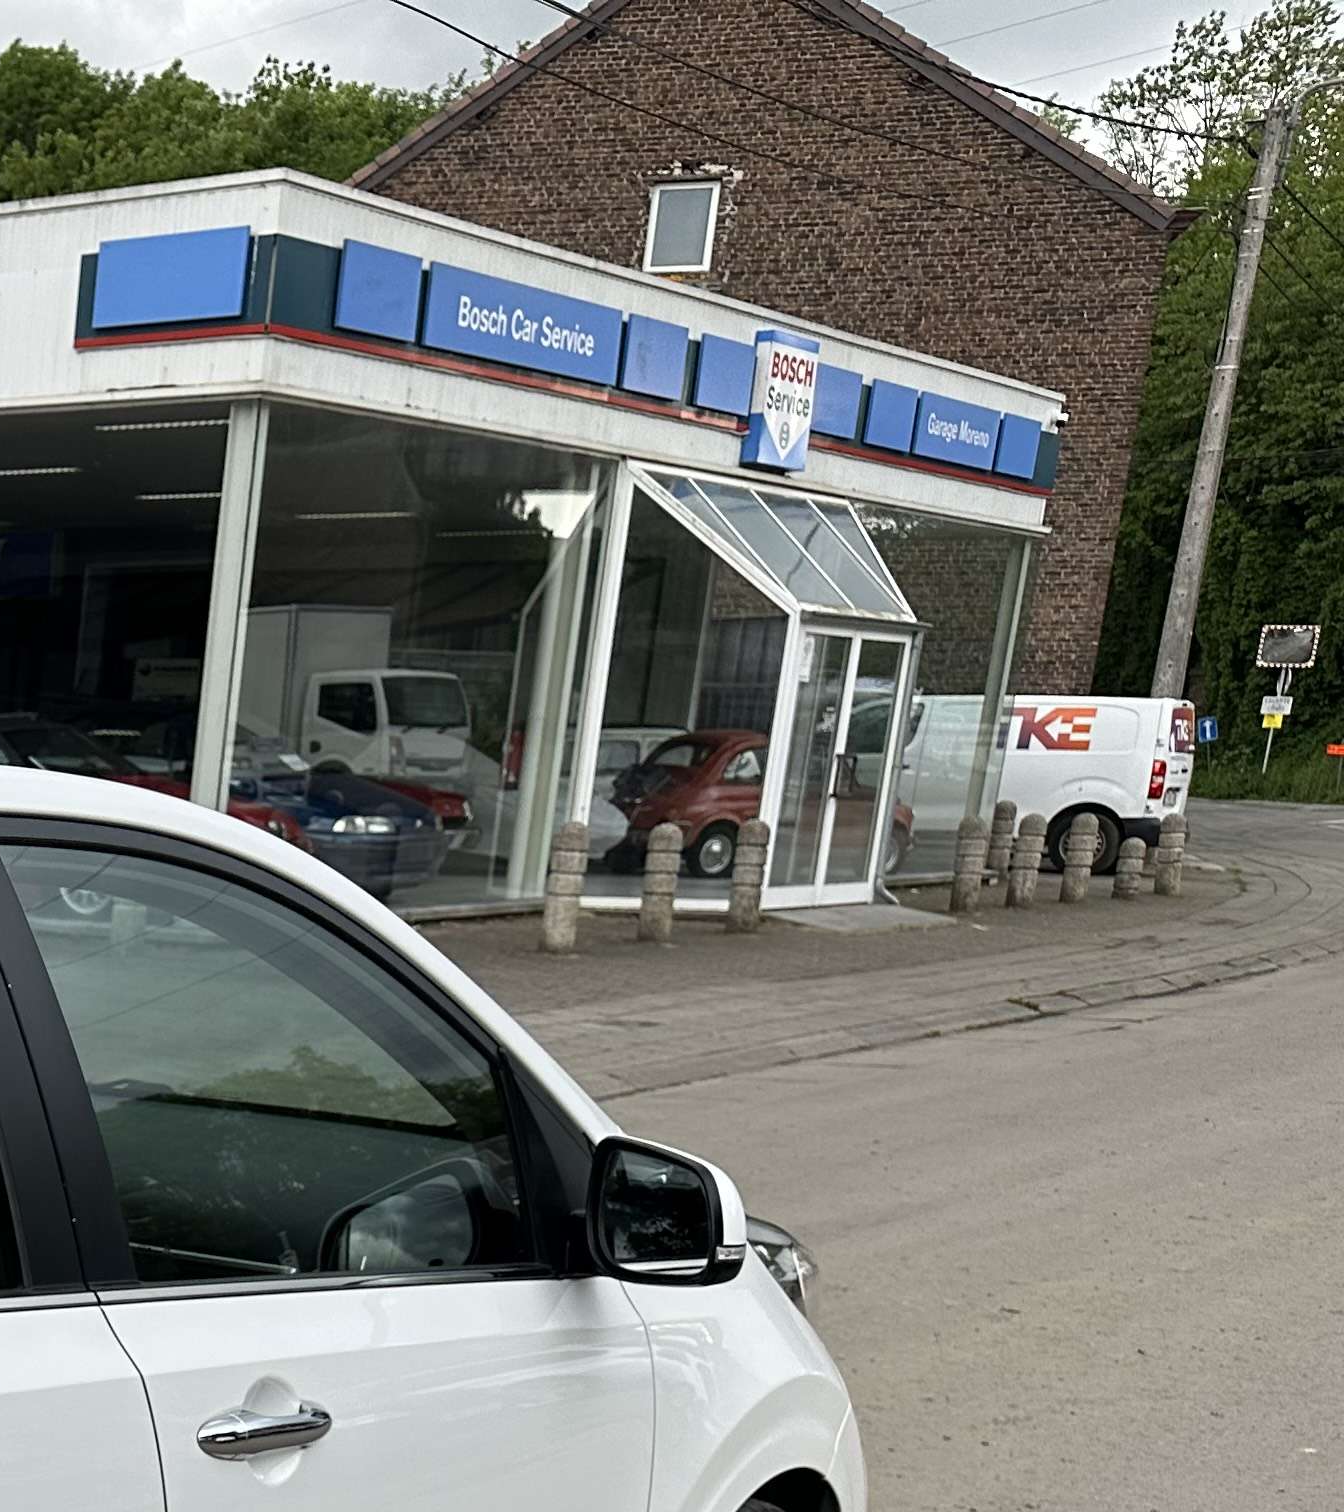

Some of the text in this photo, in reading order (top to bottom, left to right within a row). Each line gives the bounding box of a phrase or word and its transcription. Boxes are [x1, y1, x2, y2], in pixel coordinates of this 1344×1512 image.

[458, 295, 595, 357] Bosch Car Service
[771, 351, 815, 388] BOSCH
[766, 386, 811, 418] Service
[927, 412, 958, 443] Garage
